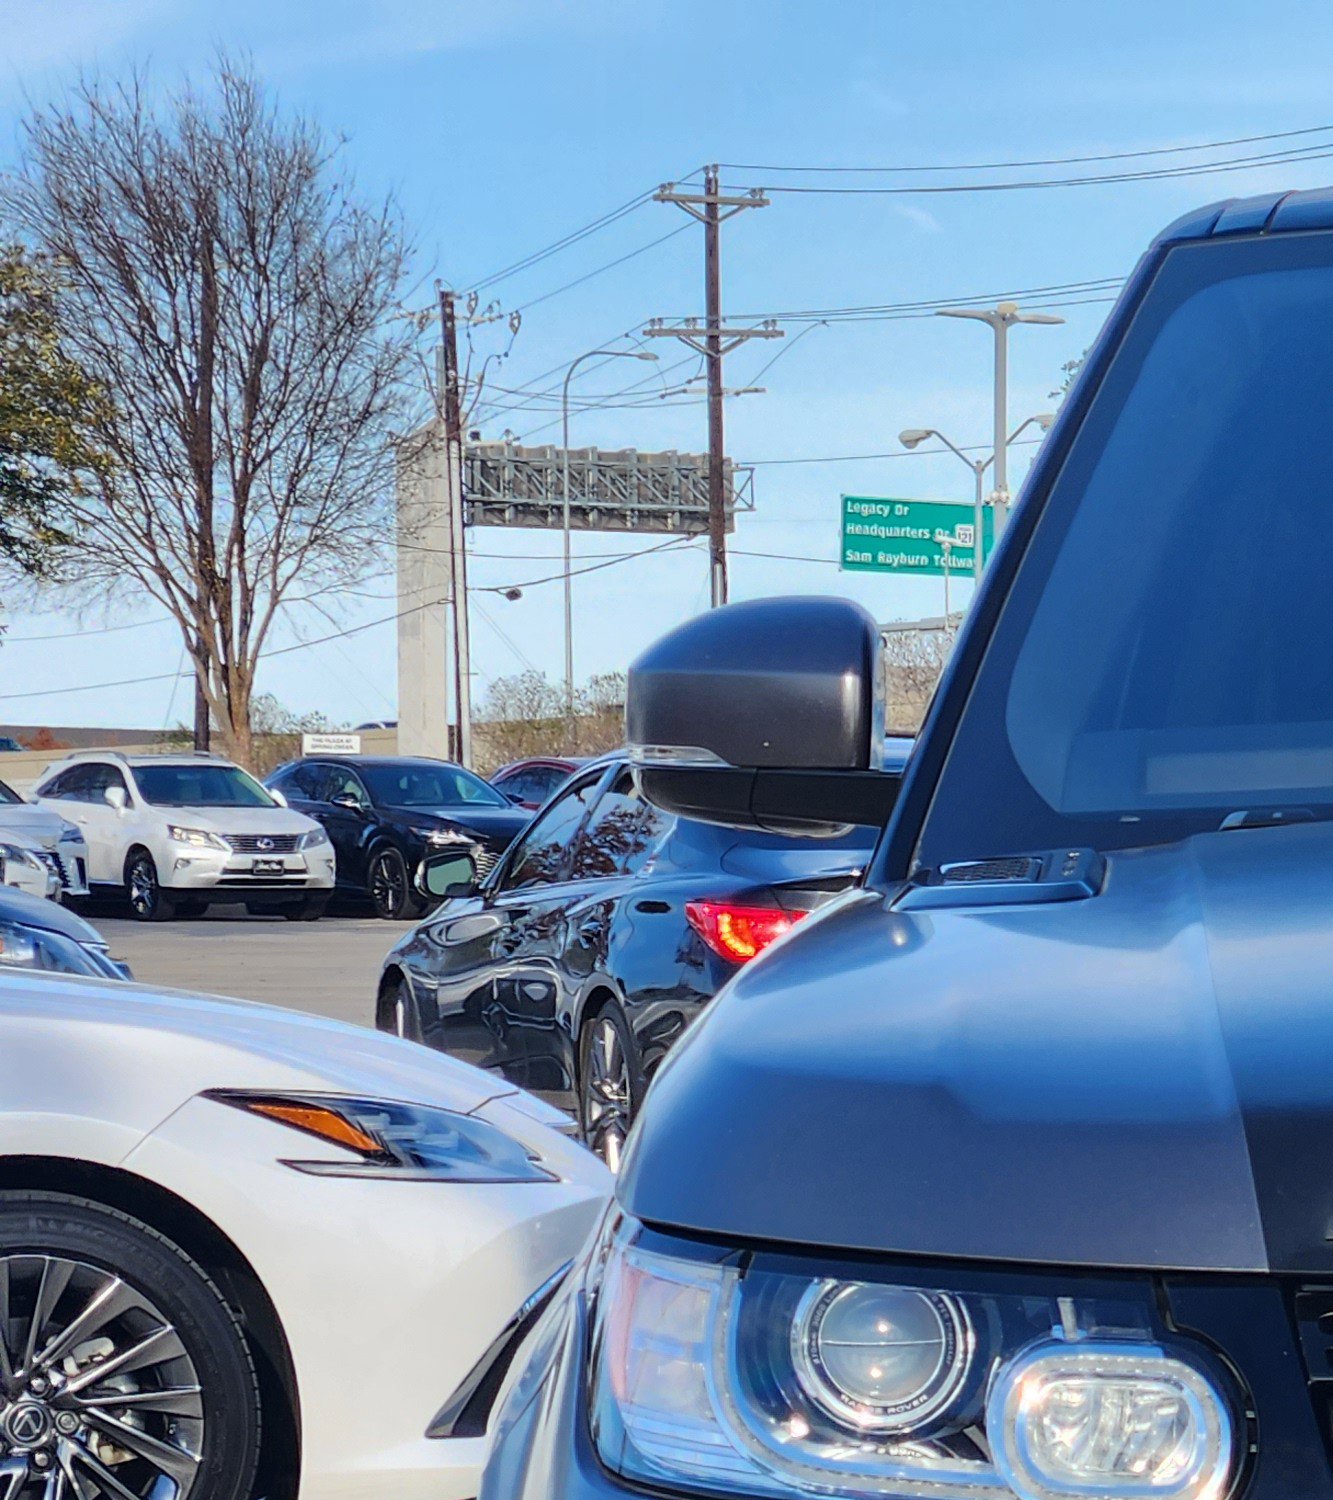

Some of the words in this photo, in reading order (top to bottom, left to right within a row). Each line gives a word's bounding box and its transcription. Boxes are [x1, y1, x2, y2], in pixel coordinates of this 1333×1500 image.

[847, 501, 890, 517] Legacy
[895, 504, 909, 516] Dr
[846, 523, 930, 540] Headquarters
[846, 550, 872, 563] Sam
[878, 551, 929, 567] Rayburn
[933, 554, 975, 568] Tollwa
[886, 1394, 928, 1414] ROVER
